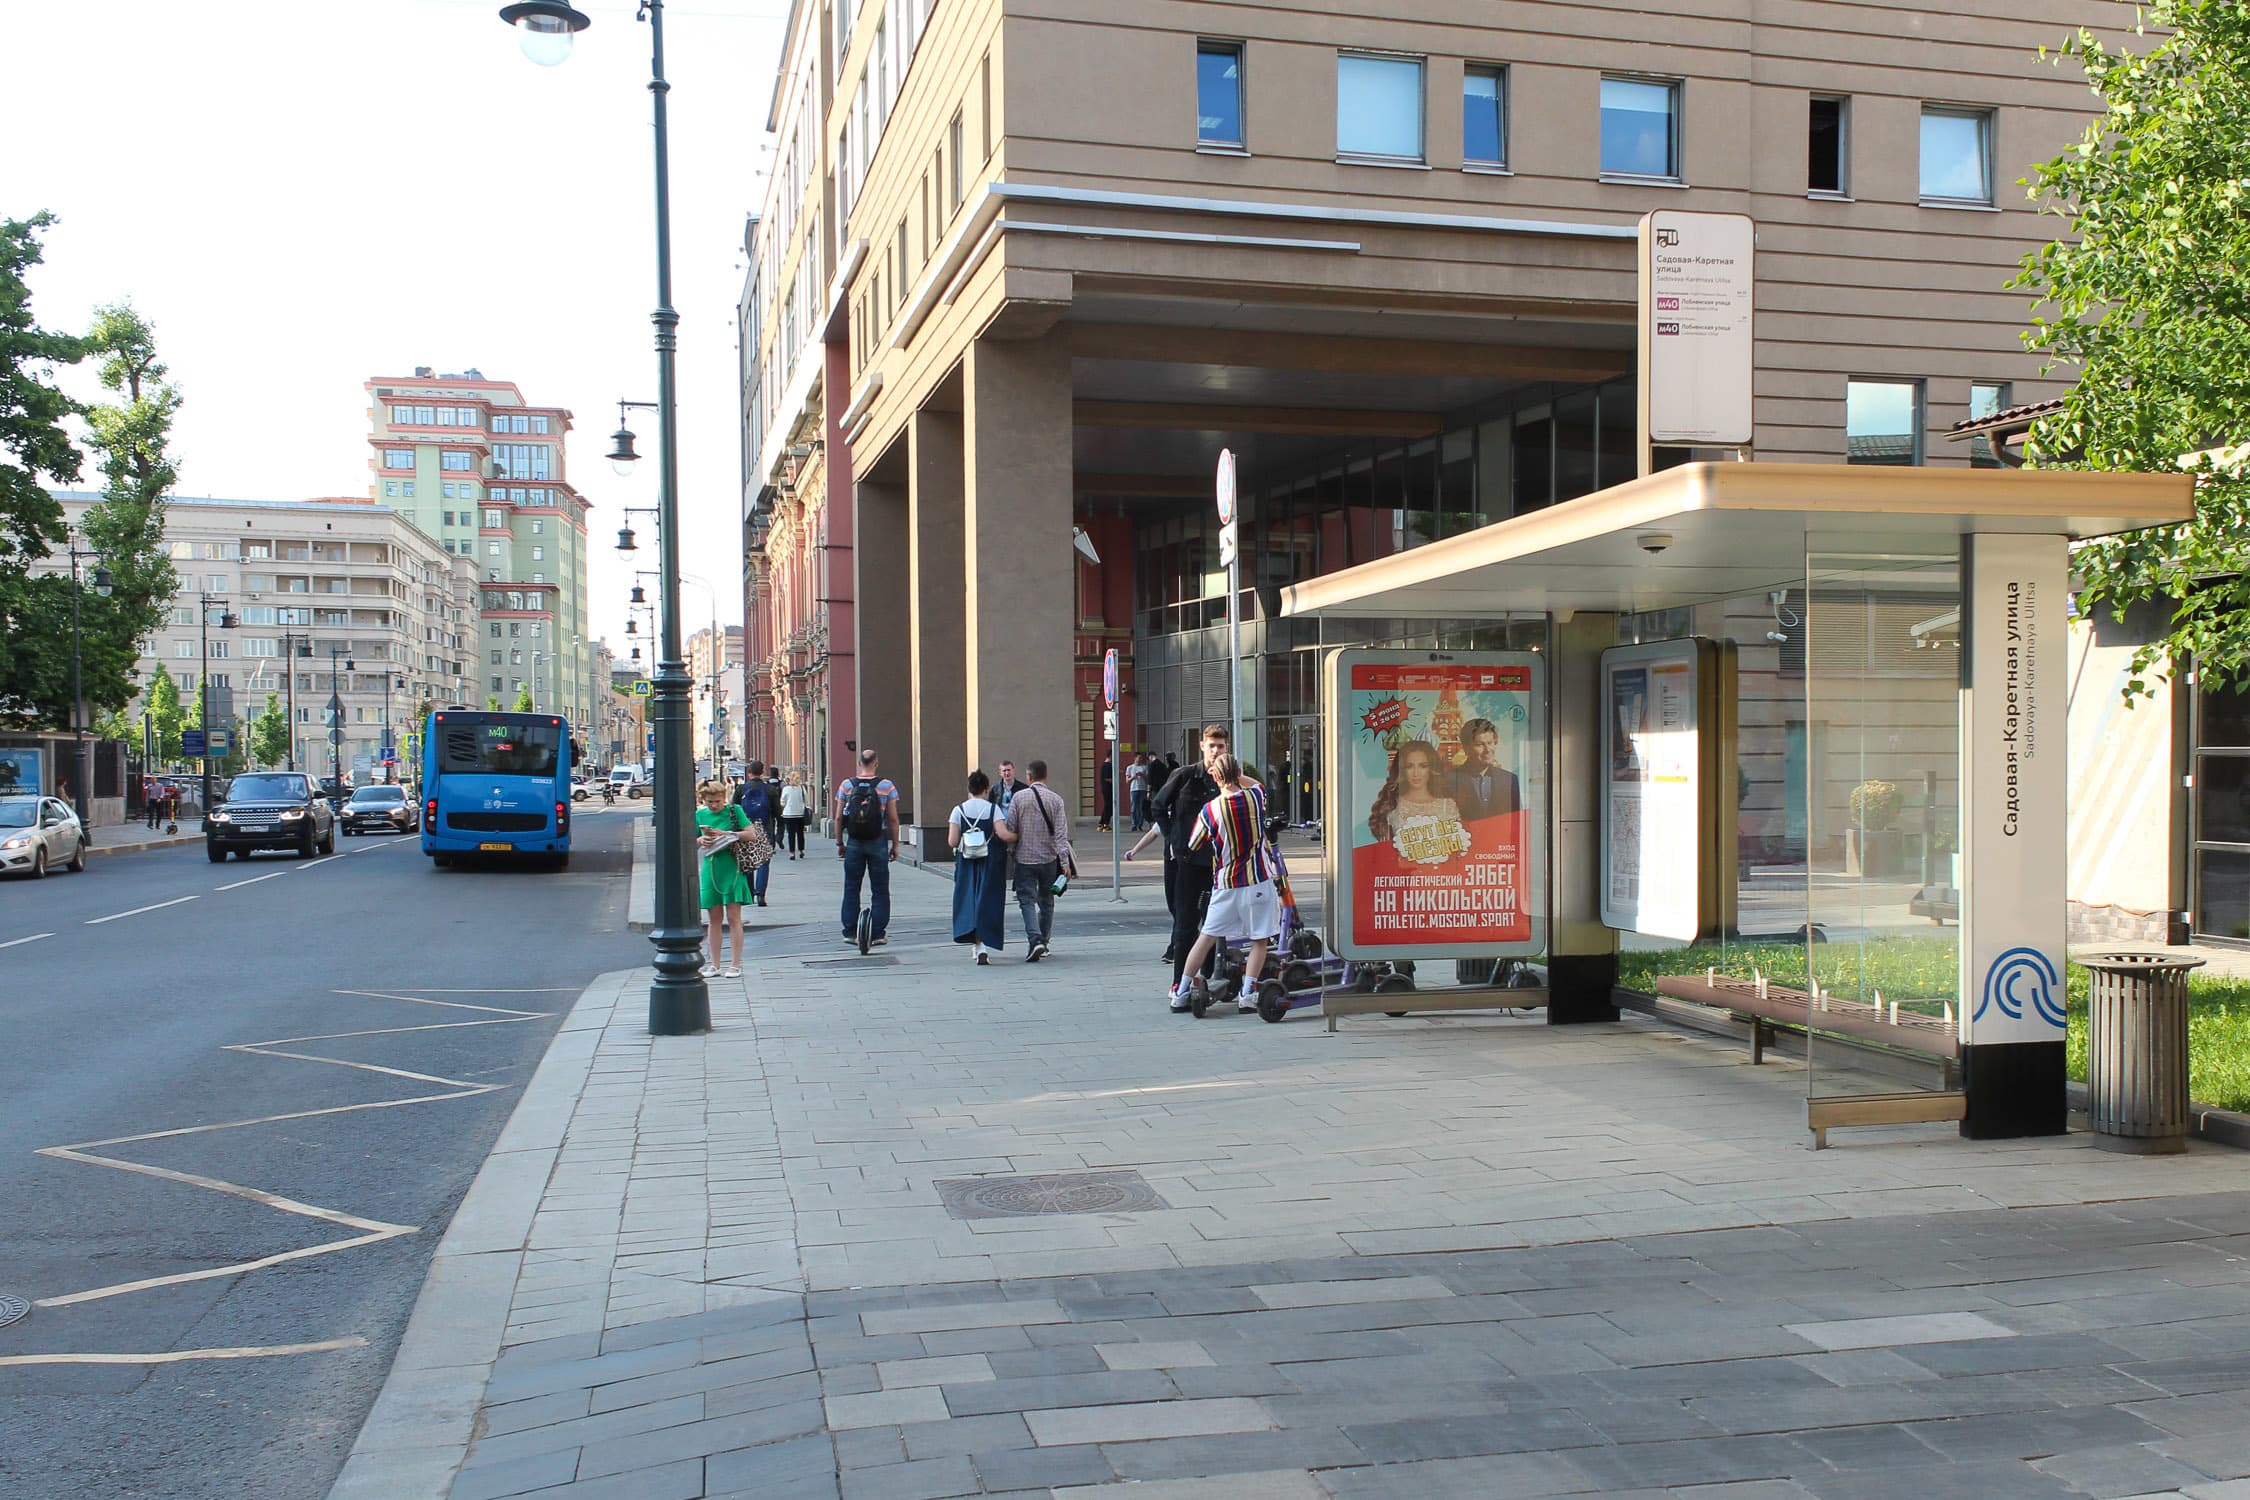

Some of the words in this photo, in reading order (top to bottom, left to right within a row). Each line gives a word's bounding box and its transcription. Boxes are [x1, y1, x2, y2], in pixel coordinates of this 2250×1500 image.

[1657, 255, 1734, 265] Садовая-Каретная
[1657, 266, 1682, 274] улица
[2007, 582, 2021, 641] улица
[2024, 582, 2036, 619] Ulitsa
[2024, 623, 2037, 759] Sadovaya-Karetnaya
[2003, 646, 2021, 837] Садовая-Каретная
[1401, 824, 1434, 843] БЕГУТ
[1436, 820, 1458, 835] ВСЕ
[1475, 852, 1515, 860] СВОБОДНЫЙ
[1374, 873, 1463, 888] ЛЕГКОАТЛЕТИЧЕСКИЙ
[1464, 863, 1516, 886] ЗАБЕГ
[1374, 890, 1397, 912] НА
[1403, 886, 1516, 912] НИКОЛЬСКОЙ
[1374, 912, 1515, 929] ATHLETIC.MOSCOW.SPORT
